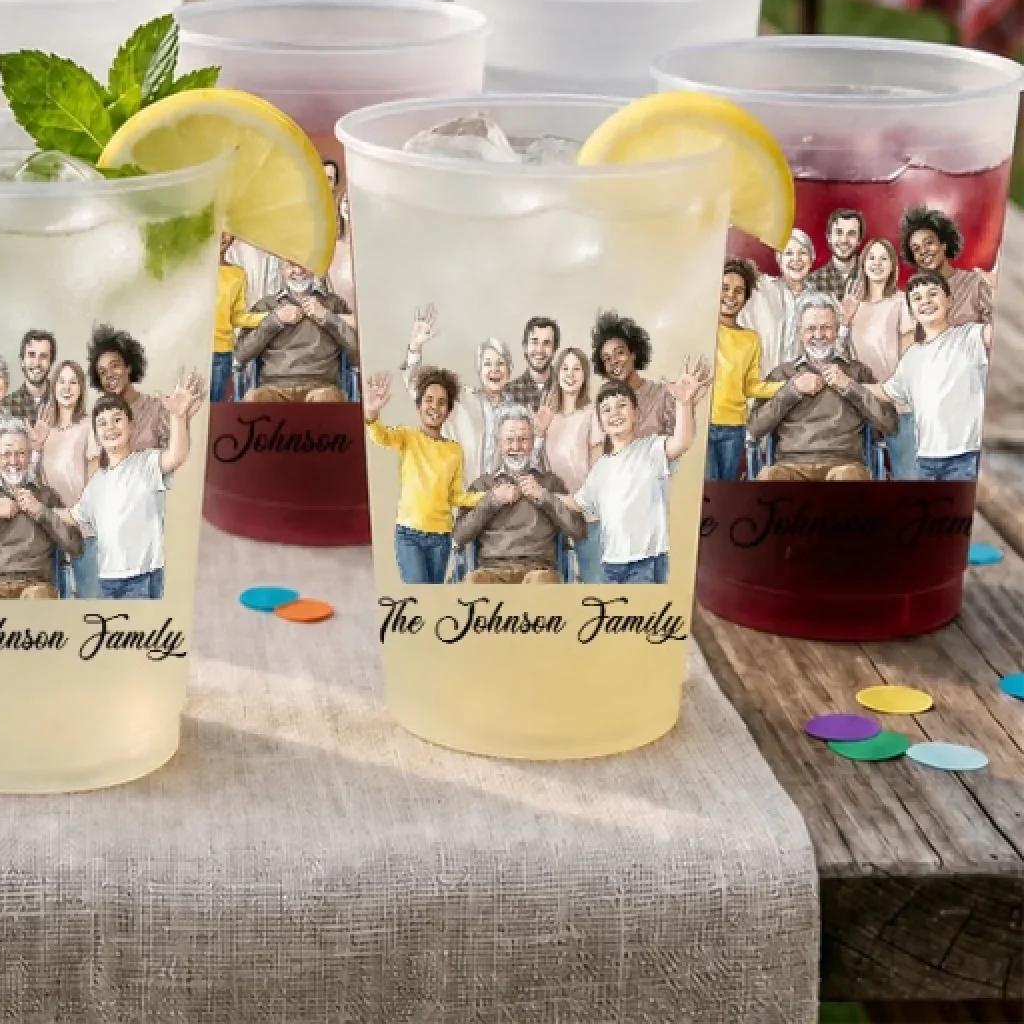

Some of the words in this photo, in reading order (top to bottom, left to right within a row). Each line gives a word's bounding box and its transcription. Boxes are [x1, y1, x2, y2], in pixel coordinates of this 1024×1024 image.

[213, 415, 354, 463] Johnson
[896, 496, 973, 548] Fam
[78, 613, 188, 661] Family
[377, 595, 425, 645] The
[434, 596, 567, 645] Johnson
[576, 595, 688, 645] Family
